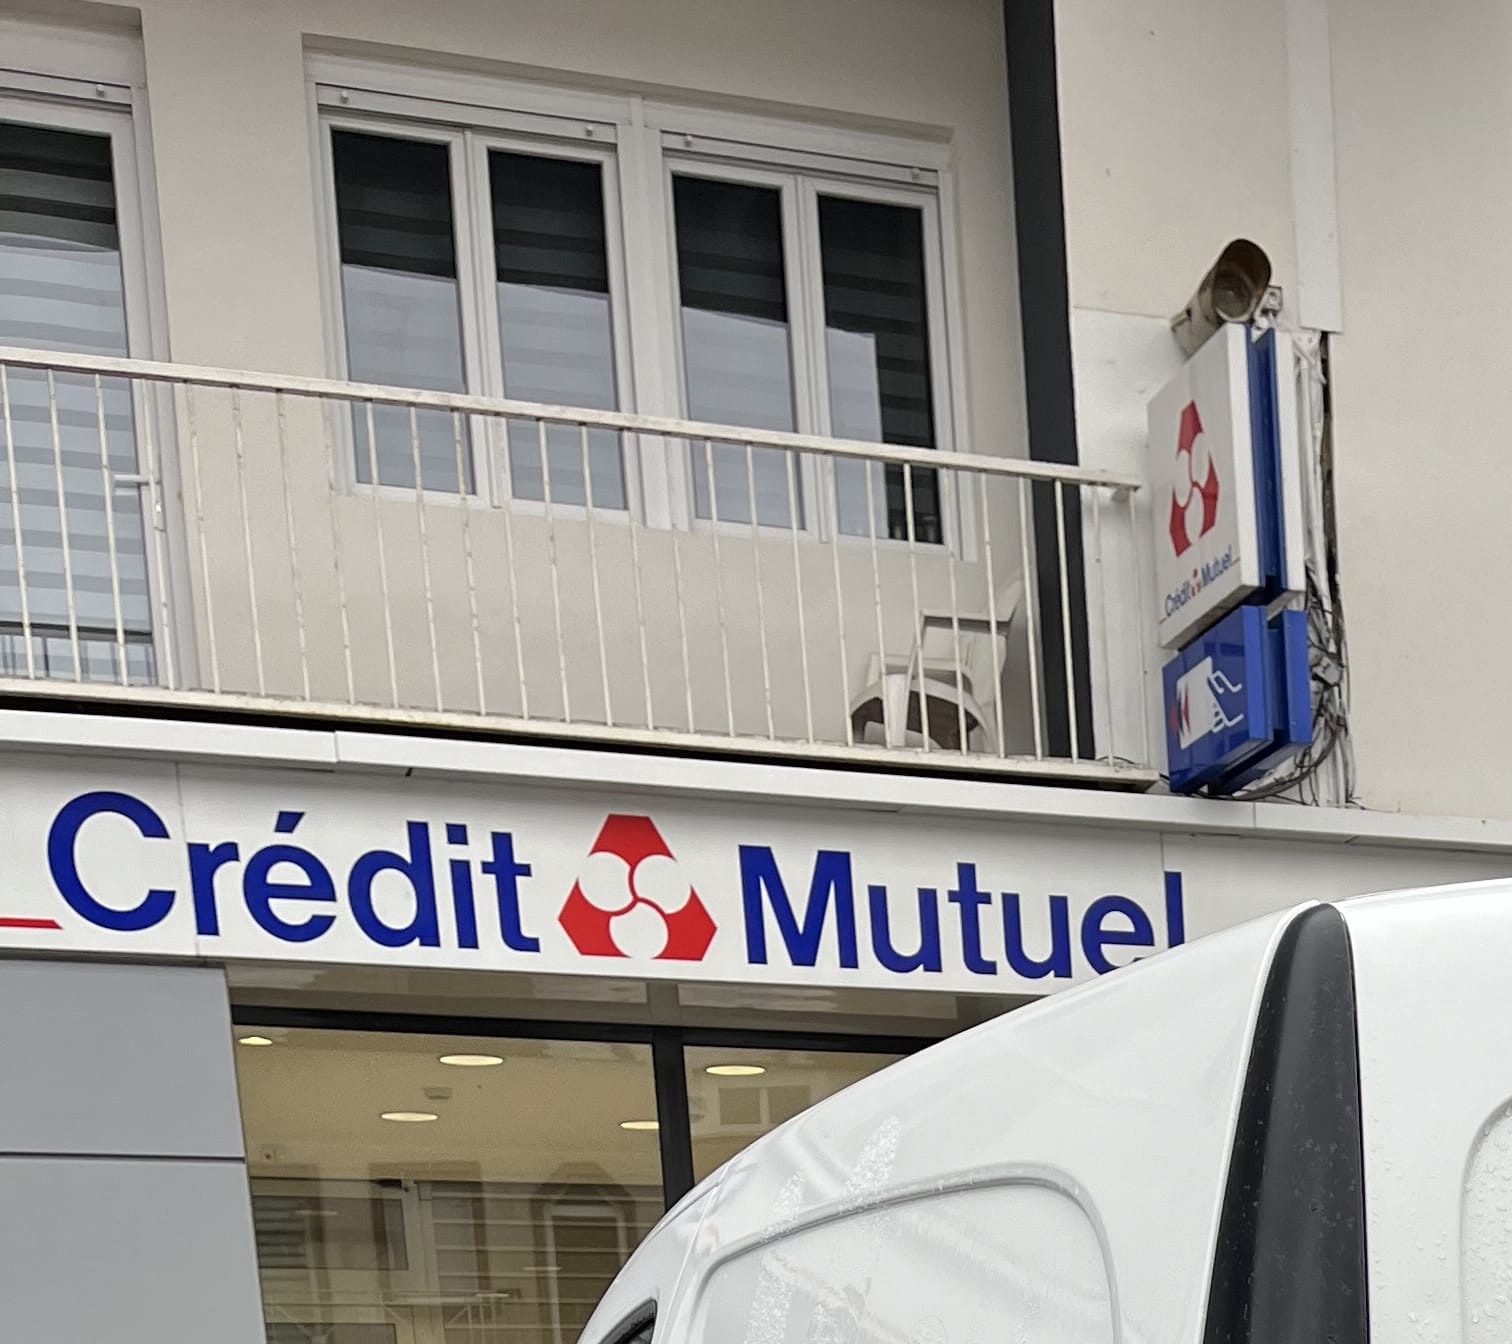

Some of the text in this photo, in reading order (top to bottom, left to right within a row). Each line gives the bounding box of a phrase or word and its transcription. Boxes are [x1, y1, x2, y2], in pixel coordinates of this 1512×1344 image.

[1201, 544, 1232, 586] Mutuel
[46, 789, 1186, 977] Crédit Mutuel
